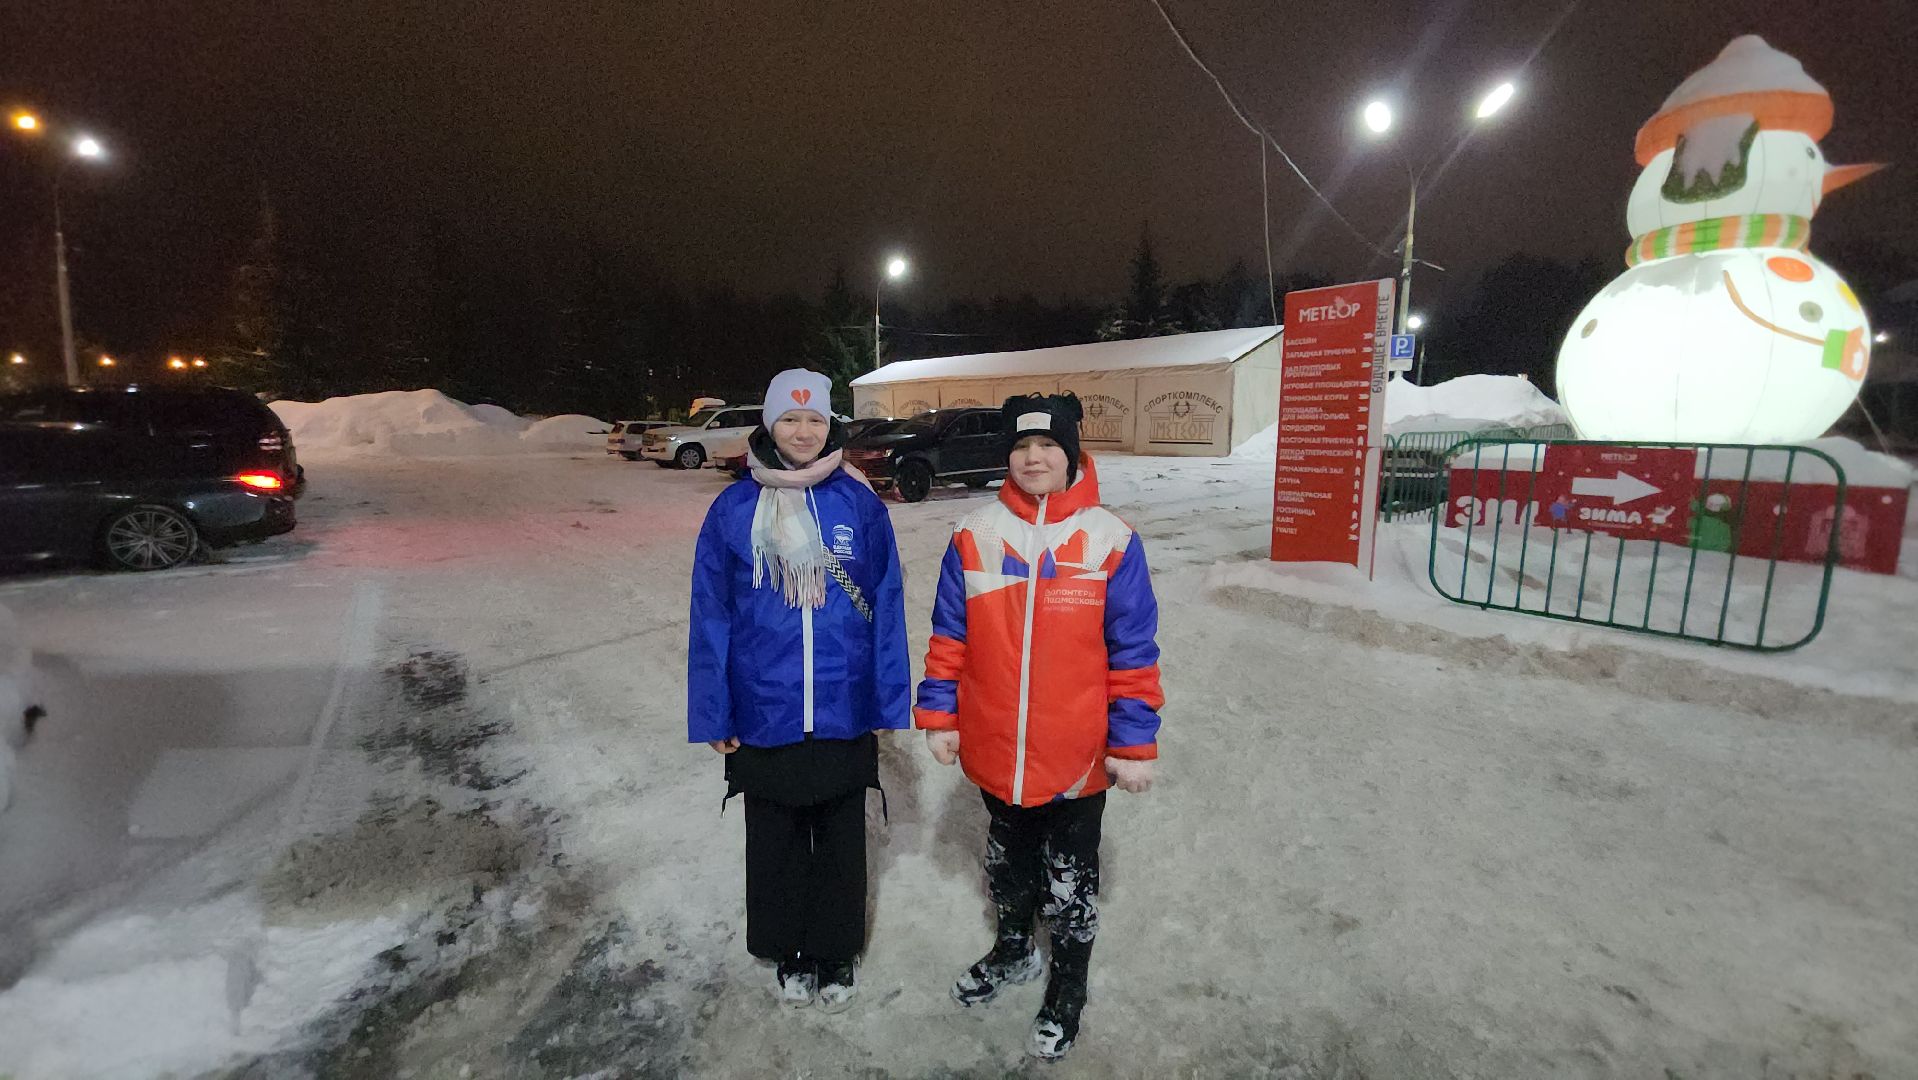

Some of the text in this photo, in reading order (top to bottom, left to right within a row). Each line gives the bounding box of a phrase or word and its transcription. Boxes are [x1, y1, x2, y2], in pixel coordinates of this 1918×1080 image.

[1299, 303, 1360, 323] МЕТЕОР
[1372, 295, 1389, 393] БУДУЩЕЕ ВМЕСТЕ
[1144, 391, 1223, 414] СПОРТКОМПЛЕКС
[1579, 507, 1642, 524] ЗИМА
